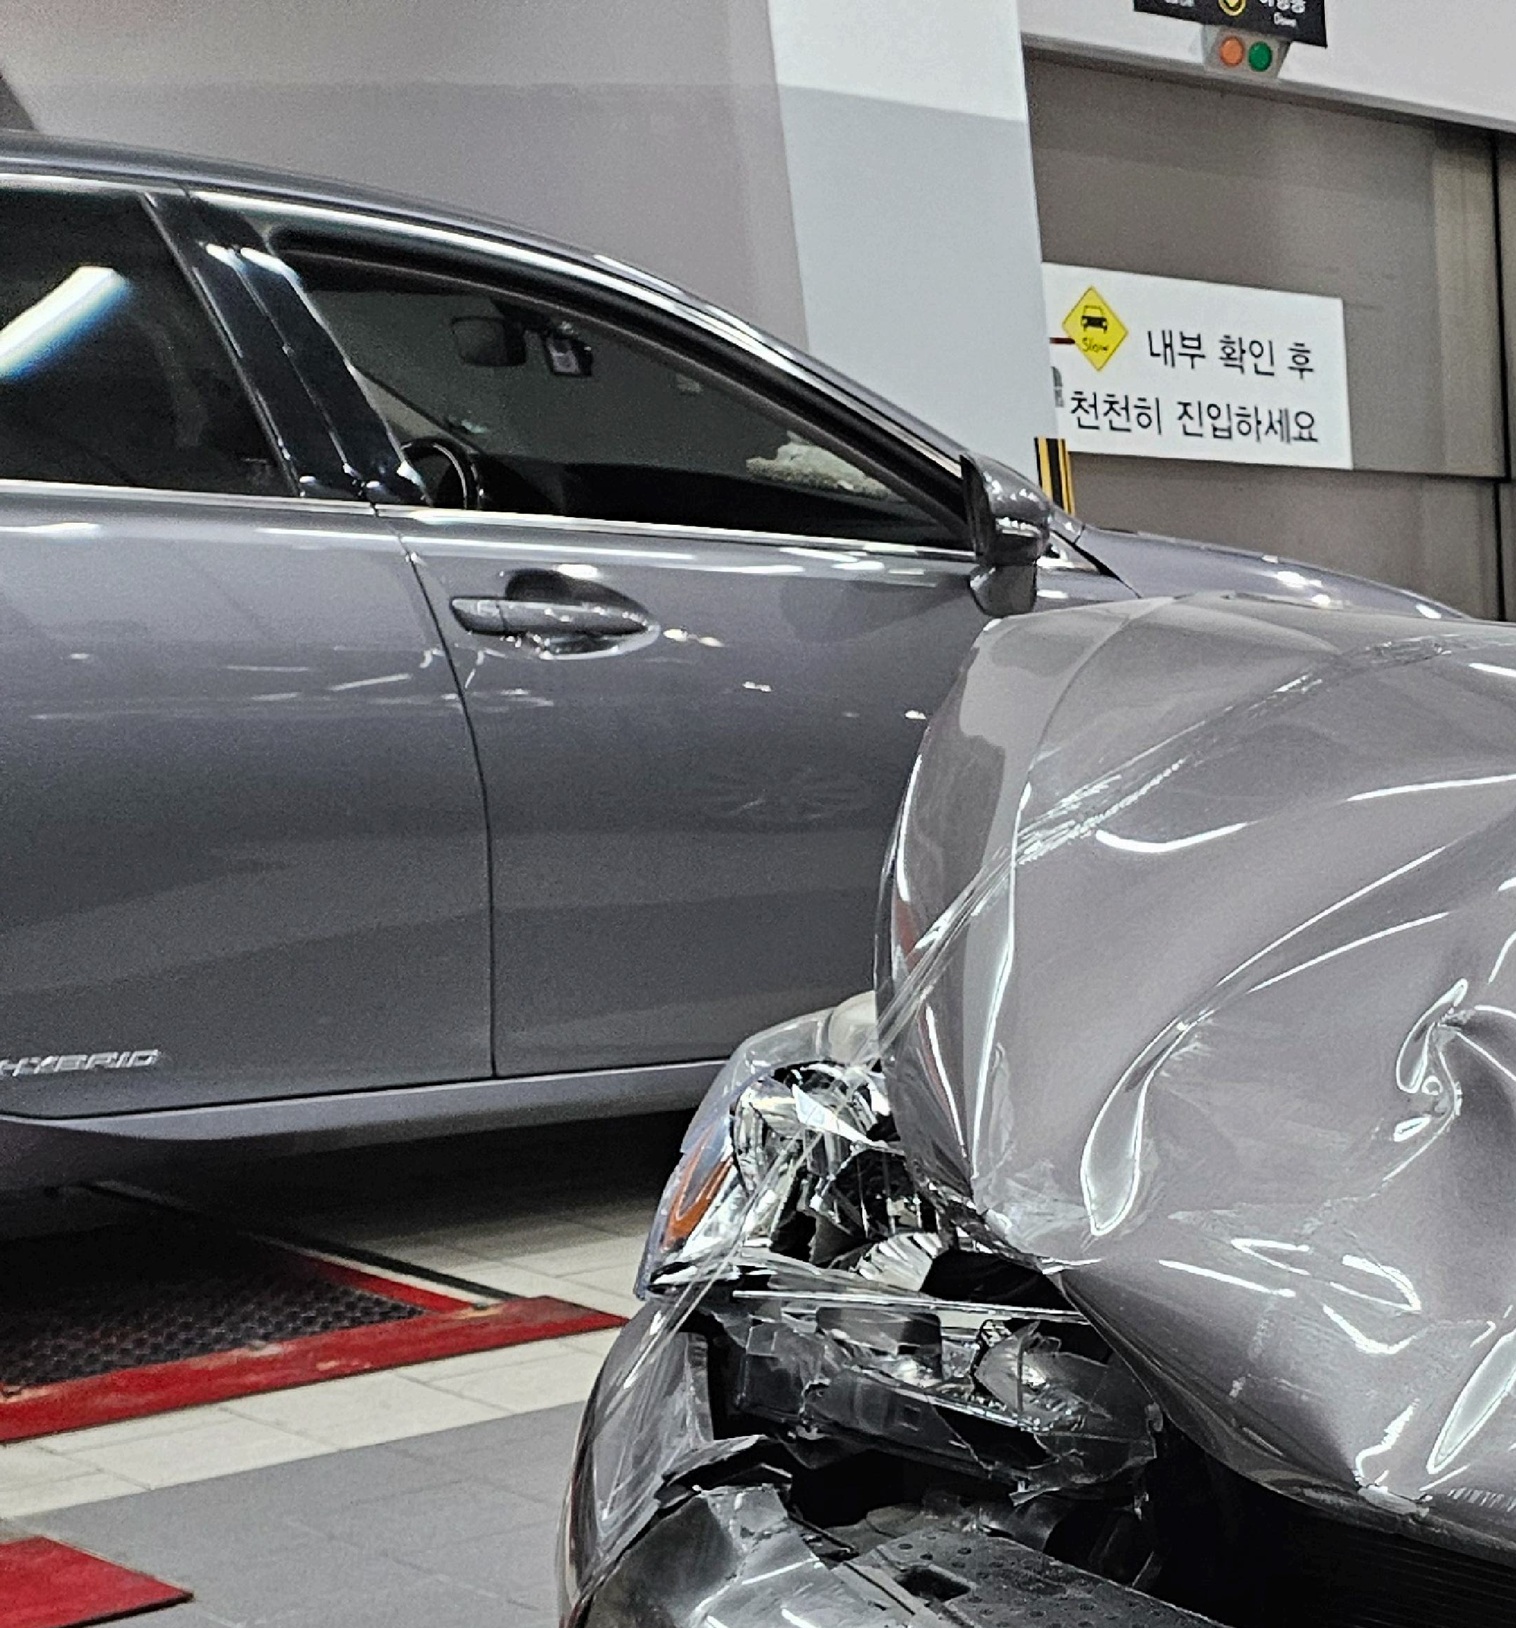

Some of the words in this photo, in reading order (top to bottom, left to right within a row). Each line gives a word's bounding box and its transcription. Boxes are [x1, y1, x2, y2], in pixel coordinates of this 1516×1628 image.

[1147, 329, 1206, 369] 내부
[1219, 334, 1276, 376] 확인
[1287, 341, 1315, 380] 후
[1070, 390, 1163, 435] 천천히
[1176, 399, 1319, 443] 진입하세요
